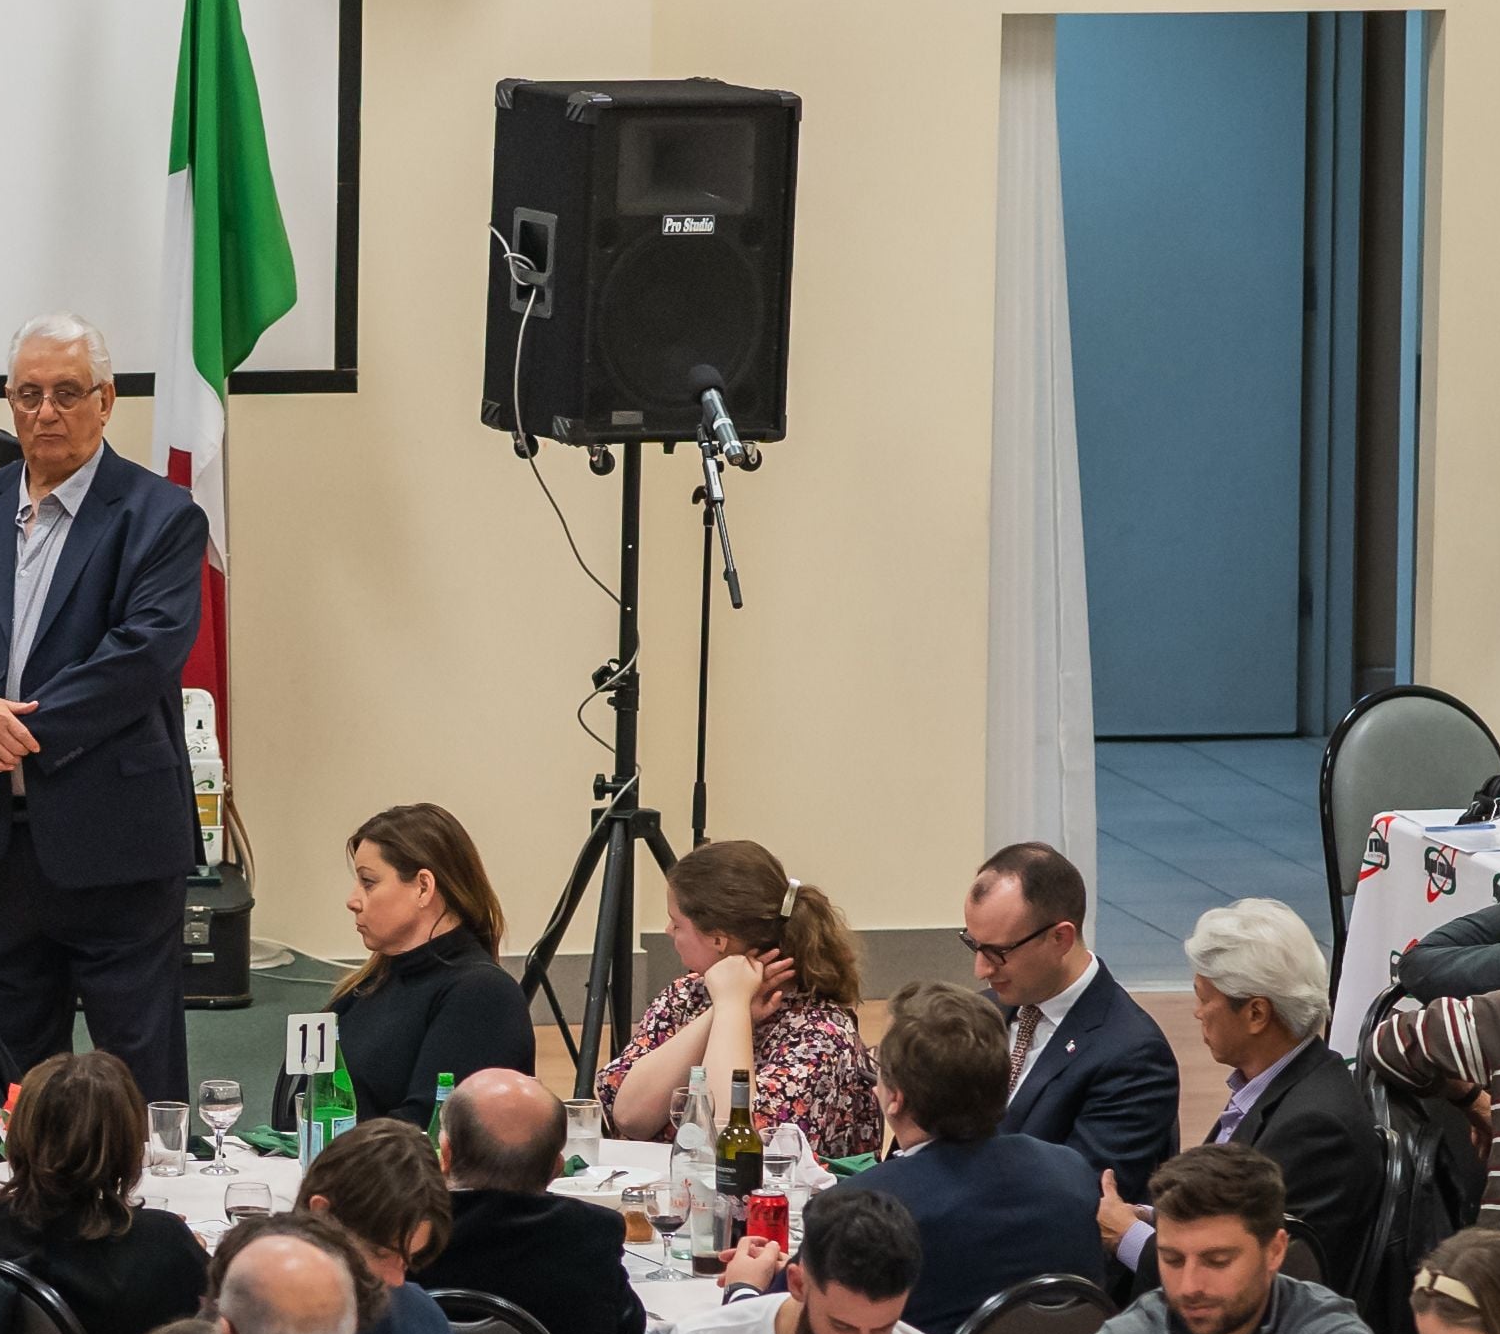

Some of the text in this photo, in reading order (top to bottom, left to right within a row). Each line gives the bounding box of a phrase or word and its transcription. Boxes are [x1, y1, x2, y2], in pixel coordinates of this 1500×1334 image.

[664, 217, 713, 232] Pro Studio
[299, 1023, 325, 1063] 11
